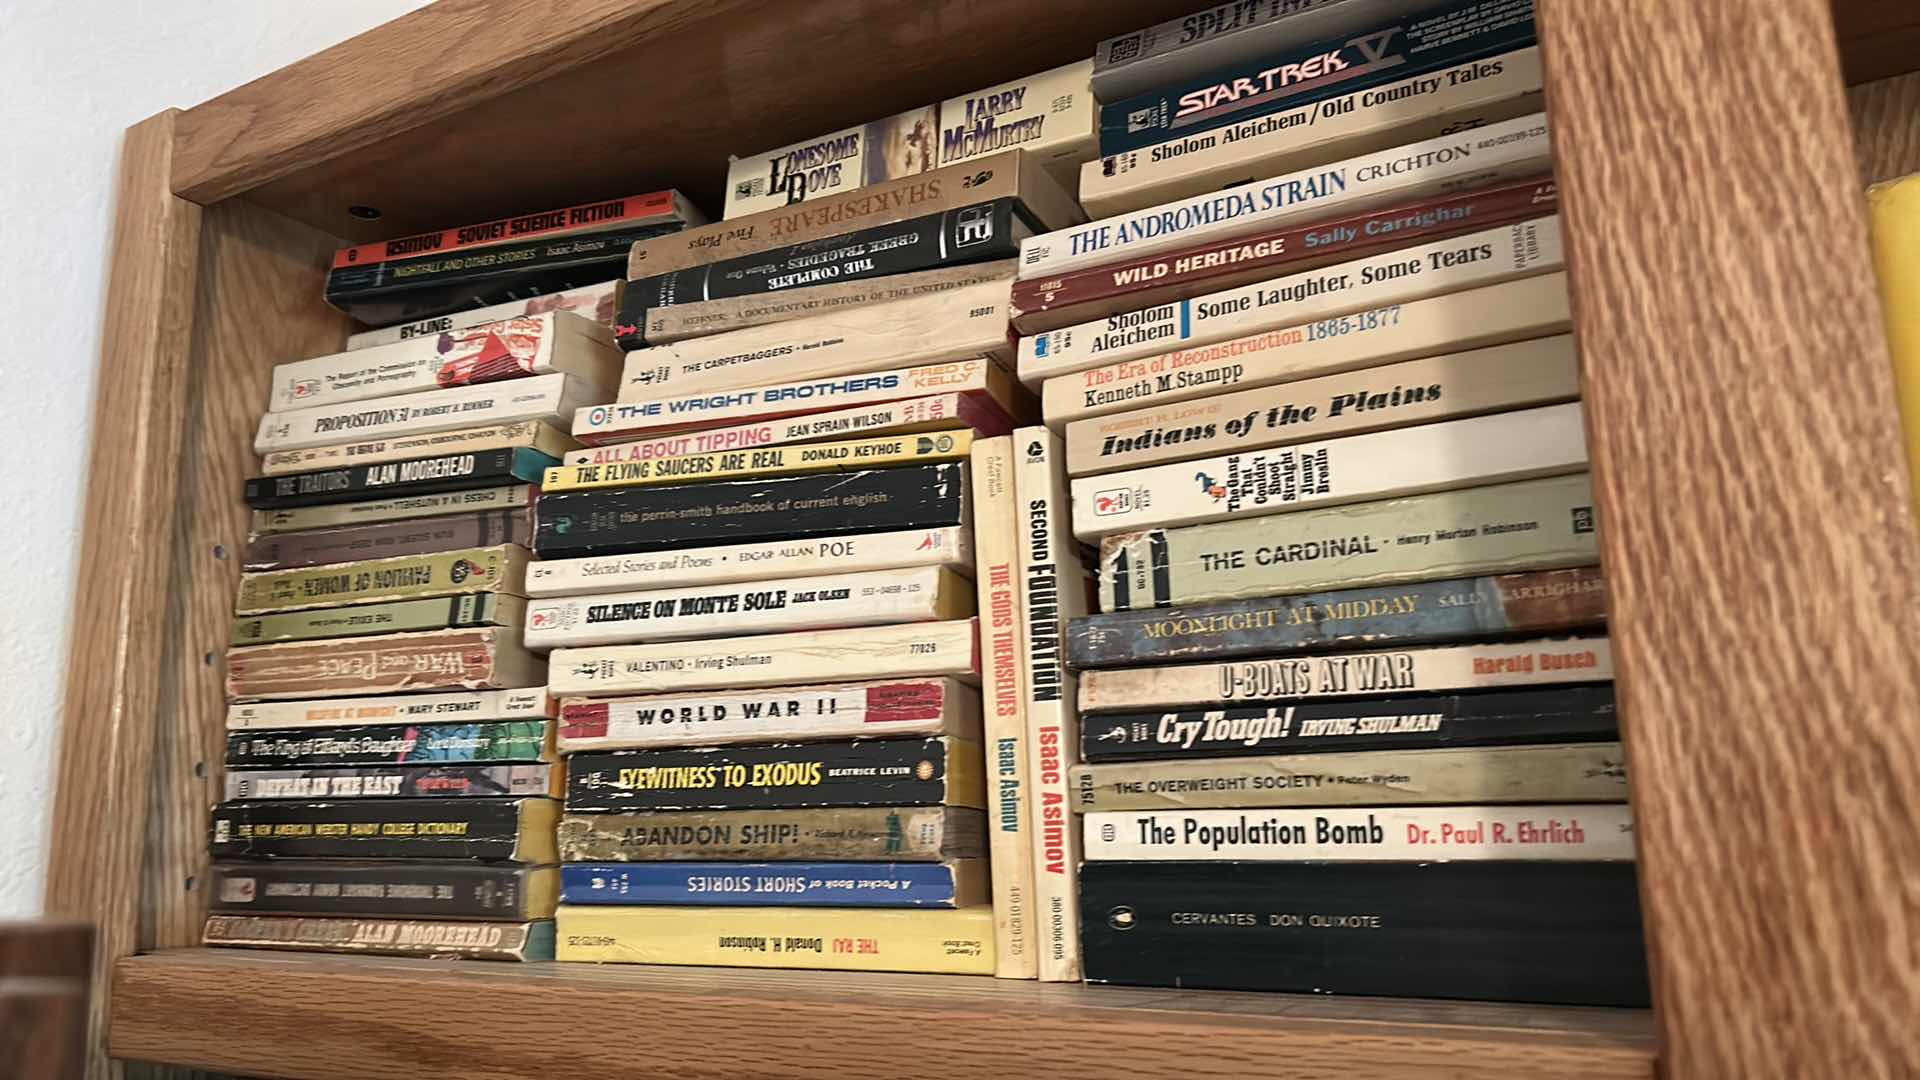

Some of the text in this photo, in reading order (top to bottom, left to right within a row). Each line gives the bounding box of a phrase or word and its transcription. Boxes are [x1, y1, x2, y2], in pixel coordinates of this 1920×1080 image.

[1180, 0, 1263, 43] SPLIT
[1176, 78, 1262, 118] STAR
[1257, 48, 1350, 91] TREK
[1344, 25, 1407, 71] V
[965, 87, 1027, 131] LARRY
[1151, 134, 1216, 163] Sholom
[1362, 77, 1441, 108] Country
[1446, 61, 1504, 88] Tales
[766, 133, 859, 196] LONESOME
[783, 163, 842, 207] DOVE
[1070, 226, 1110, 255] THE
[1114, 191, 1255, 245] ANDROMEDA
[1261, 168, 1346, 211] STRAIN
[1356, 144, 1471, 182] CRICHTON
[457, 222, 505, 244] SOVIET
[510, 211, 566, 235] SCIENCE
[570, 201, 625, 225] FICTION
[770, 180, 942, 235] SHAKESPEARE
[688, 234, 723, 249] Plays
[727, 226, 755, 241] Five
[1113, 205, 1475, 287] WILD HERITAGE Sally Carrighar
[767, 258, 875, 290] THE COMPLETE
[1197, 243, 1493, 321] Some Laughter, Some Tears
[399, 318, 453, 339] BY-LINE:
[1107, 306, 1174, 332] Sholom
[1083, 306, 1401, 387] The Era of Reconstruction 1865-1877
[1092, 322, 1175, 353] Aleichem
[682, 345, 794, 374] THE CARPETBAGGERS
[617, 375, 899, 418] THE WRIGHT BROTHERS
[913, 372, 973, 389] KELLY
[1084, 376, 1152, 408] Kenneth
[1101, 381, 1442, 456] Indians of the Plains
[593, 411, 892, 465] ALL ABOUT TIPPING JEAN SPRAIN WILSON
[276, 455, 475, 496] THE TRAITORS ALAN MOOREHEAD
[576, 442, 902, 483] THE FLYING SAUCERS ARE REAL DONALD KEYHOE
[1268, 462, 1281, 495] Shoot
[1282, 451, 1297, 501] Straight
[1301, 453, 1314, 495] Jimmy
[1316, 448, 1330, 494] Breslin
[1241, 468, 1253, 497] That
[1254, 456, 1266, 504] Couldn't
[393, 496, 438, 512] NUTSHELL
[441, 495, 449, 506] A
[452, 494, 461, 505] IN
[464, 491, 496, 504] CHESS
[620, 513, 640, 524] the
[641, 504, 713, 522] perrin-smith
[714, 501, 775, 516] handbook
[776, 500, 790, 511] of
[792, 496, 838, 509] current
[842, 492, 888, 508] english
[582, 541, 855, 576] Selected Stories and Poems EDGAR ALLAN POE
[1200, 520, 1539, 572] THE CARDINAL Henry Morton Robinson
[303, 565, 432, 597] PAVILION OF WOMEN
[348, 614, 372, 626] EXILE
[375, 612, 393, 624] THE
[586, 601, 650, 623] SILENCE
[654, 600, 676, 618] ON
[679, 594, 739, 616] MONTE
[743, 590, 787, 611] SOLE
[792, 590, 816, 604] JACK
[818, 588, 850, 601] OLSEN
[1143, 591, 1484, 640] MOONLIGHT AT MIDDAY SALLY
[319, 651, 465, 681] WAR and PEACE
[626, 655, 772, 673] VALENTINO Irving Shulman
[1219, 650, 1596, 699] U-BOATS AT WAR Harald Busch
[989, 563, 1021, 832] THE GODS THEMSELVES Isaac Asimov
[1027, 499, 1065, 875] SECOND FOUNDATION Isaac Asimov
[408, 701, 481, 715] MARY STEWART
[637, 705, 727, 726] WORLD
[742, 701, 800, 718] WAR
[256, 778, 311, 798] DEFEAT
[312, 777, 331, 796] IN
[331, 777, 363, 796] THE
[362, 775, 404, 796] EAST
[619, 761, 911, 789] EYEWITNESS TO EXODUS BEATRICE LEVIN
[1115, 774, 1411, 794] THE OVERWEIGHT SOCIETY Wyden
[620, 825, 730, 847] ABANDON
[739, 823, 799, 845] SHIP!
[1137, 814, 1585, 851] The Population Bomb Dr. Paul R. Ehrlich
[687, 876, 912, 893] A Pocket Book of SHORT STORIES
[352, 924, 502, 945] ALAN MOOREHEAD
[1171, 912, 1382, 928] CERVANTES DON QUIXOTE
